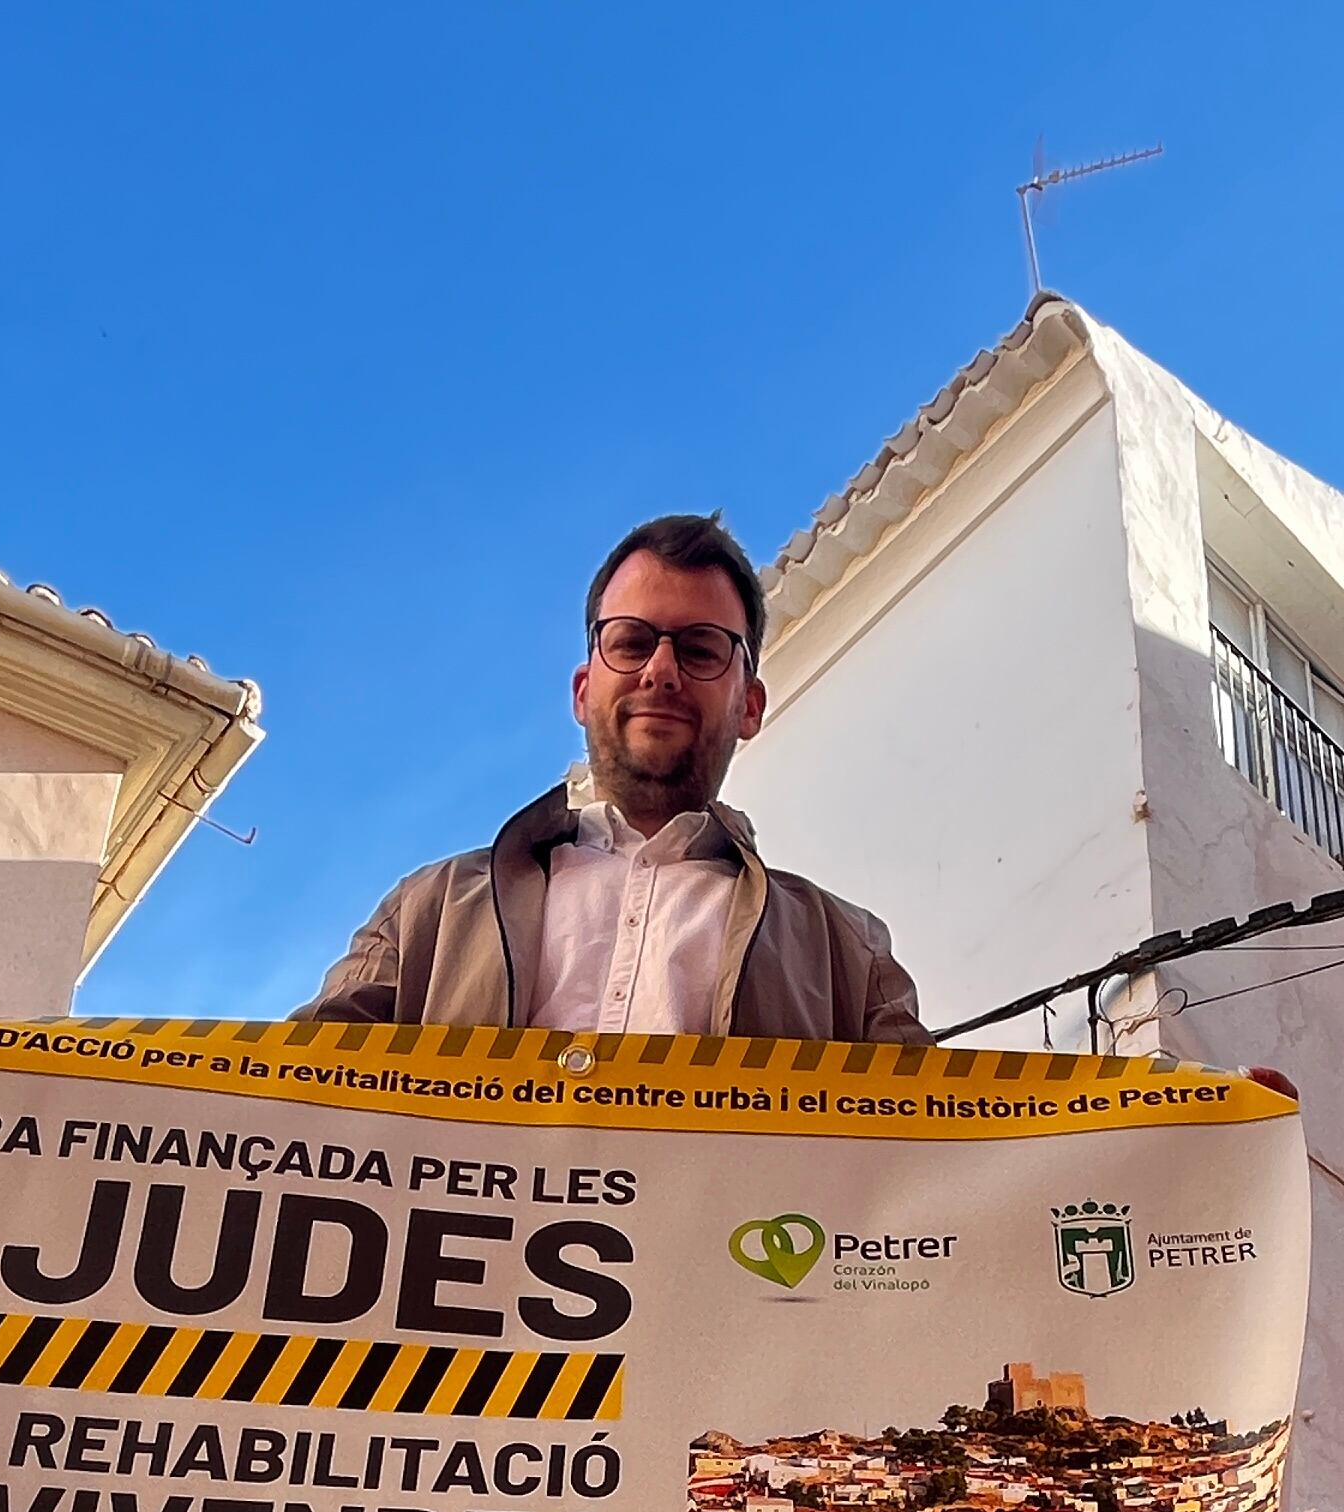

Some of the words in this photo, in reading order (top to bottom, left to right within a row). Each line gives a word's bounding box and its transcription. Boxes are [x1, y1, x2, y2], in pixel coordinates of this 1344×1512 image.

[141, 1049, 204, 1068] per
[209, 1055, 230, 1072] a
[241, 1056, 270, 1077] la
[278, 1063, 504, 1101] revitalització
[512, 1079, 564, 1103] del
[573, 1082, 685, 1107] centre
[694, 1086, 771, 1111] urbà
[780, 1087, 789, 1111] i
[798, 1090, 828, 1112] el
[836, 1096, 917, 1116] casc
[926, 1096, 1057, 1118] històric
[1067, 1094, 1110, 1114] de
[1120, 1085, 1230, 1108] Petrer
[58, 1119, 395, 1189] FINANÇADA
[409, 1157, 518, 1200] PER
[531, 1167, 638, 1204] LES
[835, 1234, 957, 1260] Petrer
[1148, 1231, 1231, 1248] Ajuntament
[1234, 1227, 1252, 1240] de
[1148, 1242, 1257, 1268] PETRER
[833, 1264, 896, 1276] Corazón
[833, 1279, 858, 1290] del
[861, 1279, 930, 1292] Vinalopó
[8, 1413, 621, 1499] REHABILITACIÓ
